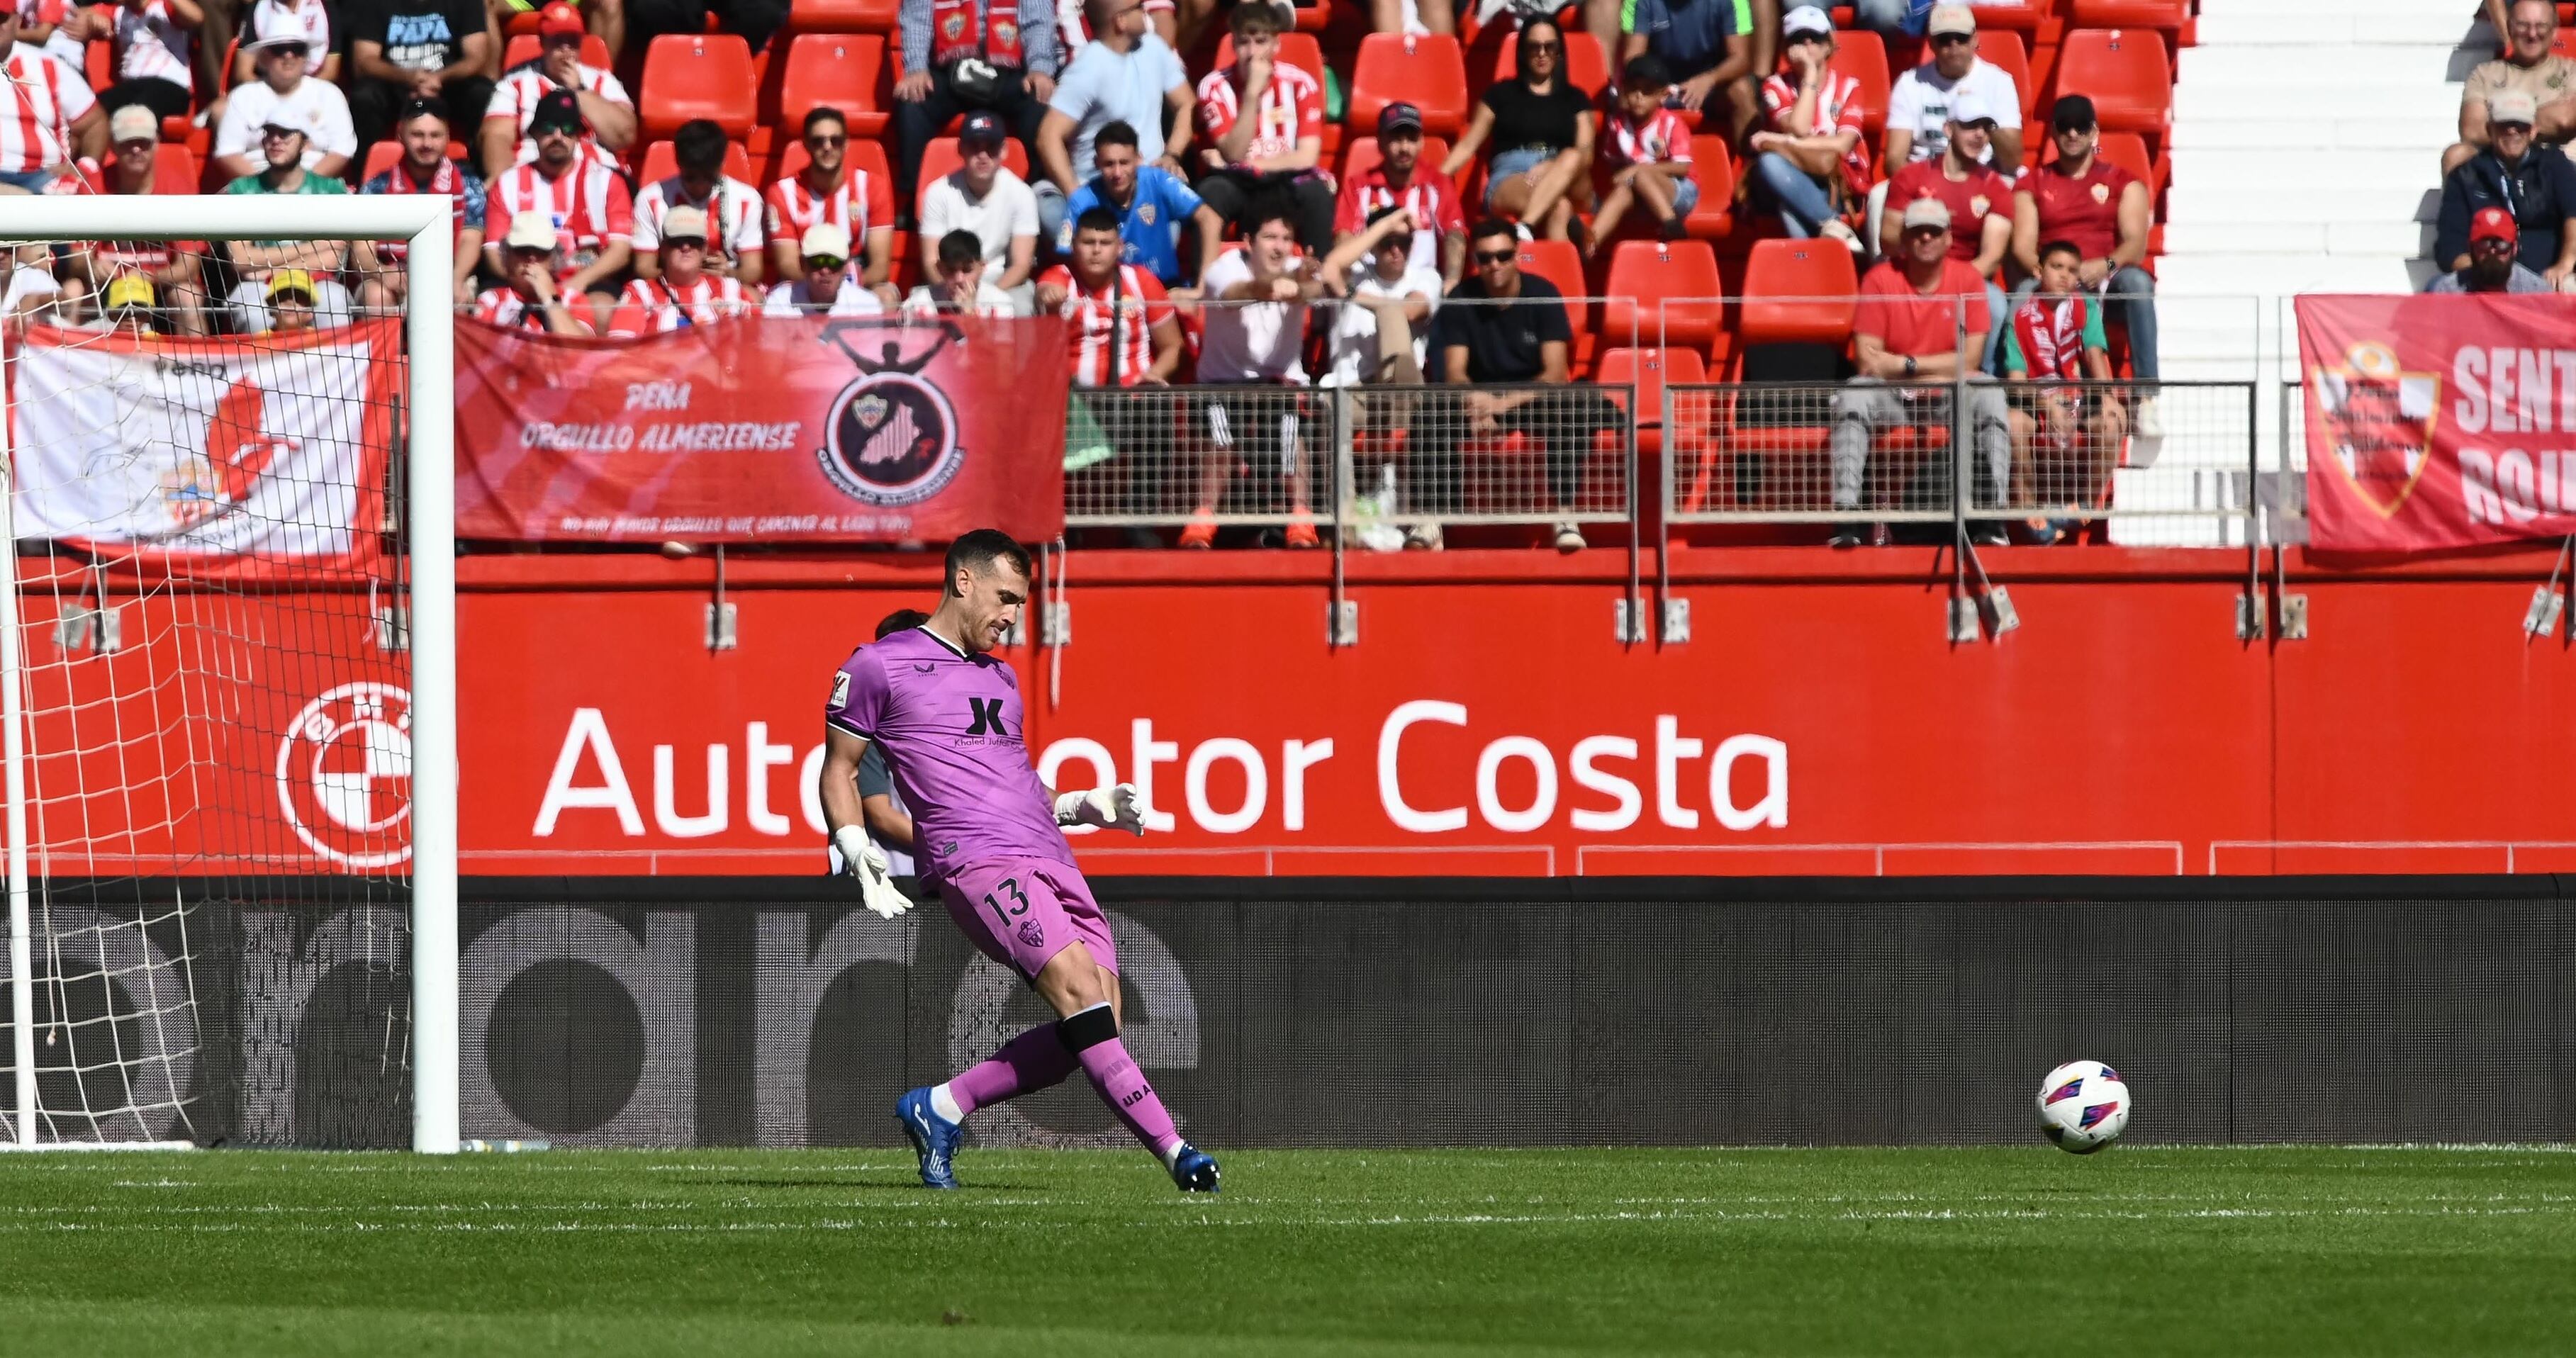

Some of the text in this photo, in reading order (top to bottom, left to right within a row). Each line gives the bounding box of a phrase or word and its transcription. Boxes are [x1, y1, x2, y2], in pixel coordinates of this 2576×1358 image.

[520, 421, 801, 452] ORGULLO ALMERIENSE
[954, 737, 986, 748] Khaled
[1377, 700, 1788, 832] Costa
[984, 877, 1029, 928] 13
[1122, 1084, 1152, 1107] UDA
